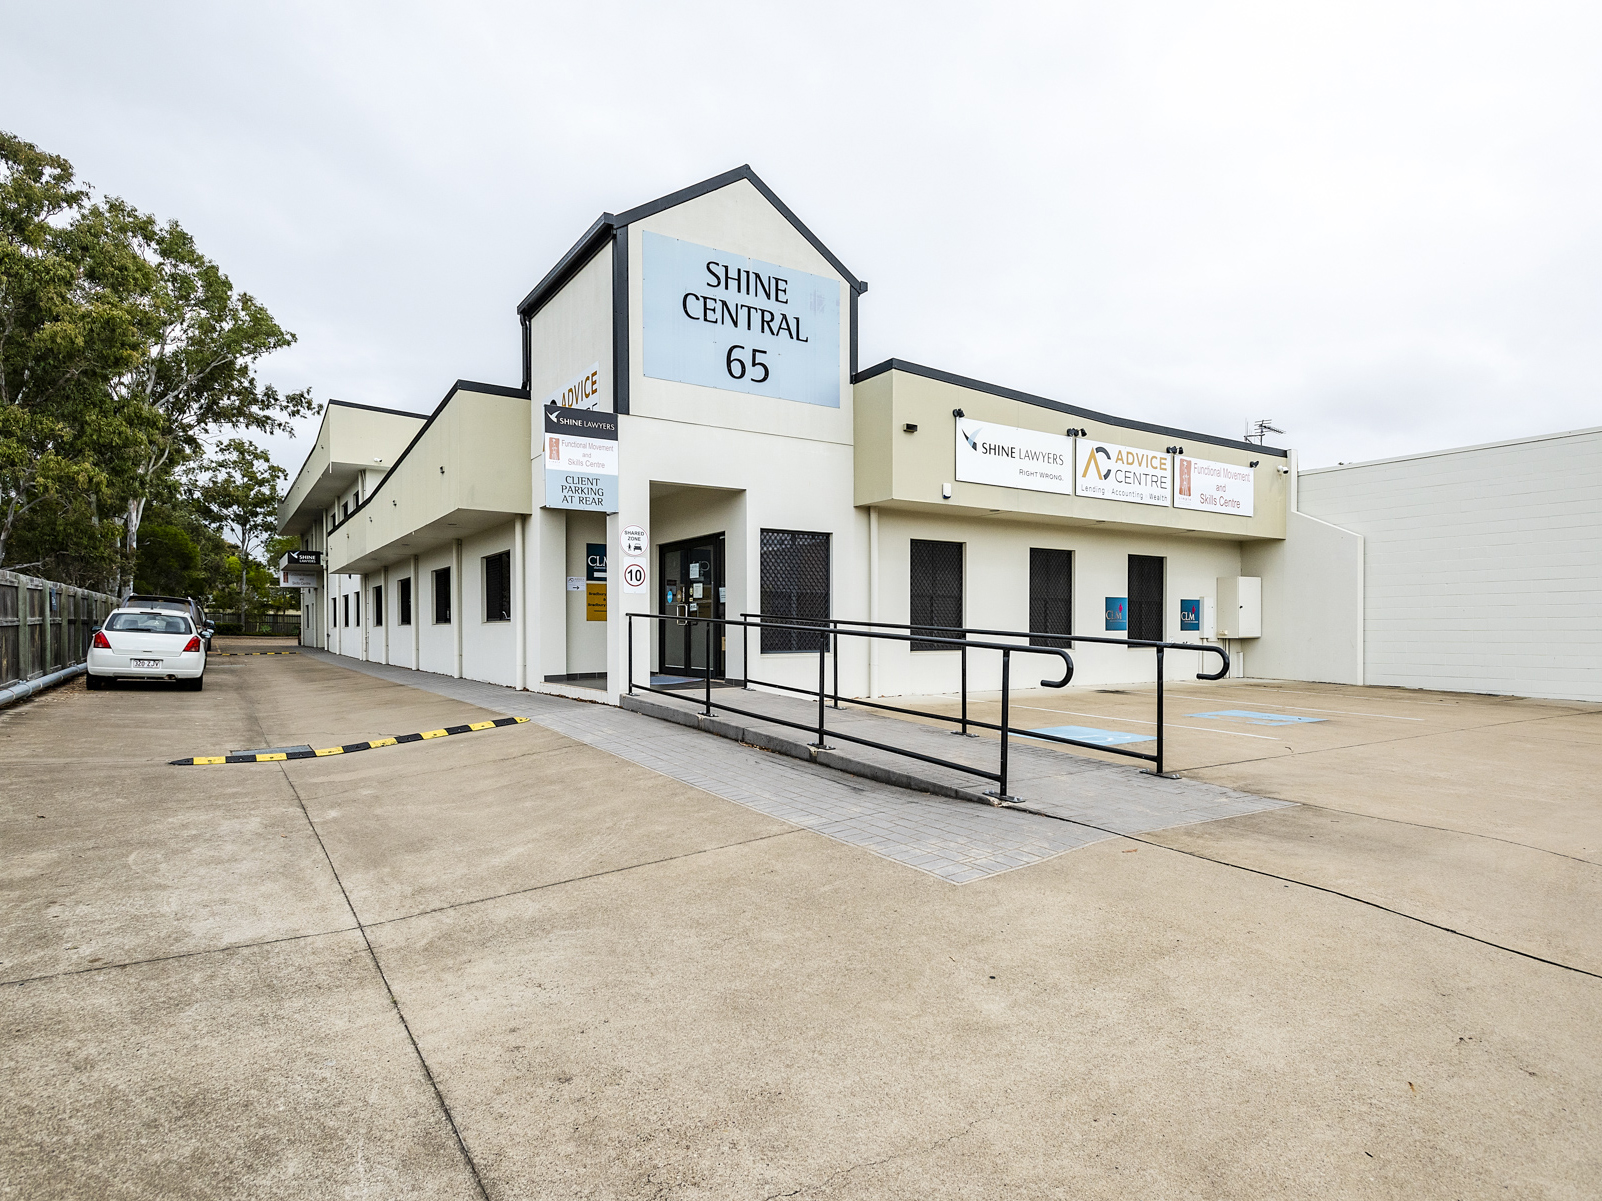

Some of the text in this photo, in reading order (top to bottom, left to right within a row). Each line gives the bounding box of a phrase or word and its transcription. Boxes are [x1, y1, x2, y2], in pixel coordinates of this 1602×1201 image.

[706, 261, 788, 304] SHINE
[682, 292, 809, 343] CENTRAL
[726, 344, 769, 383] 65
[562, 370, 598, 408] ADVICE
[560, 417, 615, 431] SHINE LAWYERS
[561, 440, 614, 452] Functional Movement
[982, 442, 1064, 466] SHINE LAWYERS
[1115, 449, 1167, 471] ADVICE
[567, 458, 606, 469] Skills Centre
[1114, 469, 1167, 490] CENTRE
[1193, 462, 1251, 482] Functional Movement
[565, 475, 600, 487] CLIENT
[1215, 484, 1227, 493] and
[561, 485, 604, 497] PARKING
[1081, 484, 1168, 502] Lending Accounting Wealth
[561, 495, 604, 507] AT REAR
[1200, 493, 1241, 509] Skills Centre
[627, 569, 642, 582] 10
[1105, 610, 1122, 620] CLM
[1181, 611, 1195, 621] CLM
